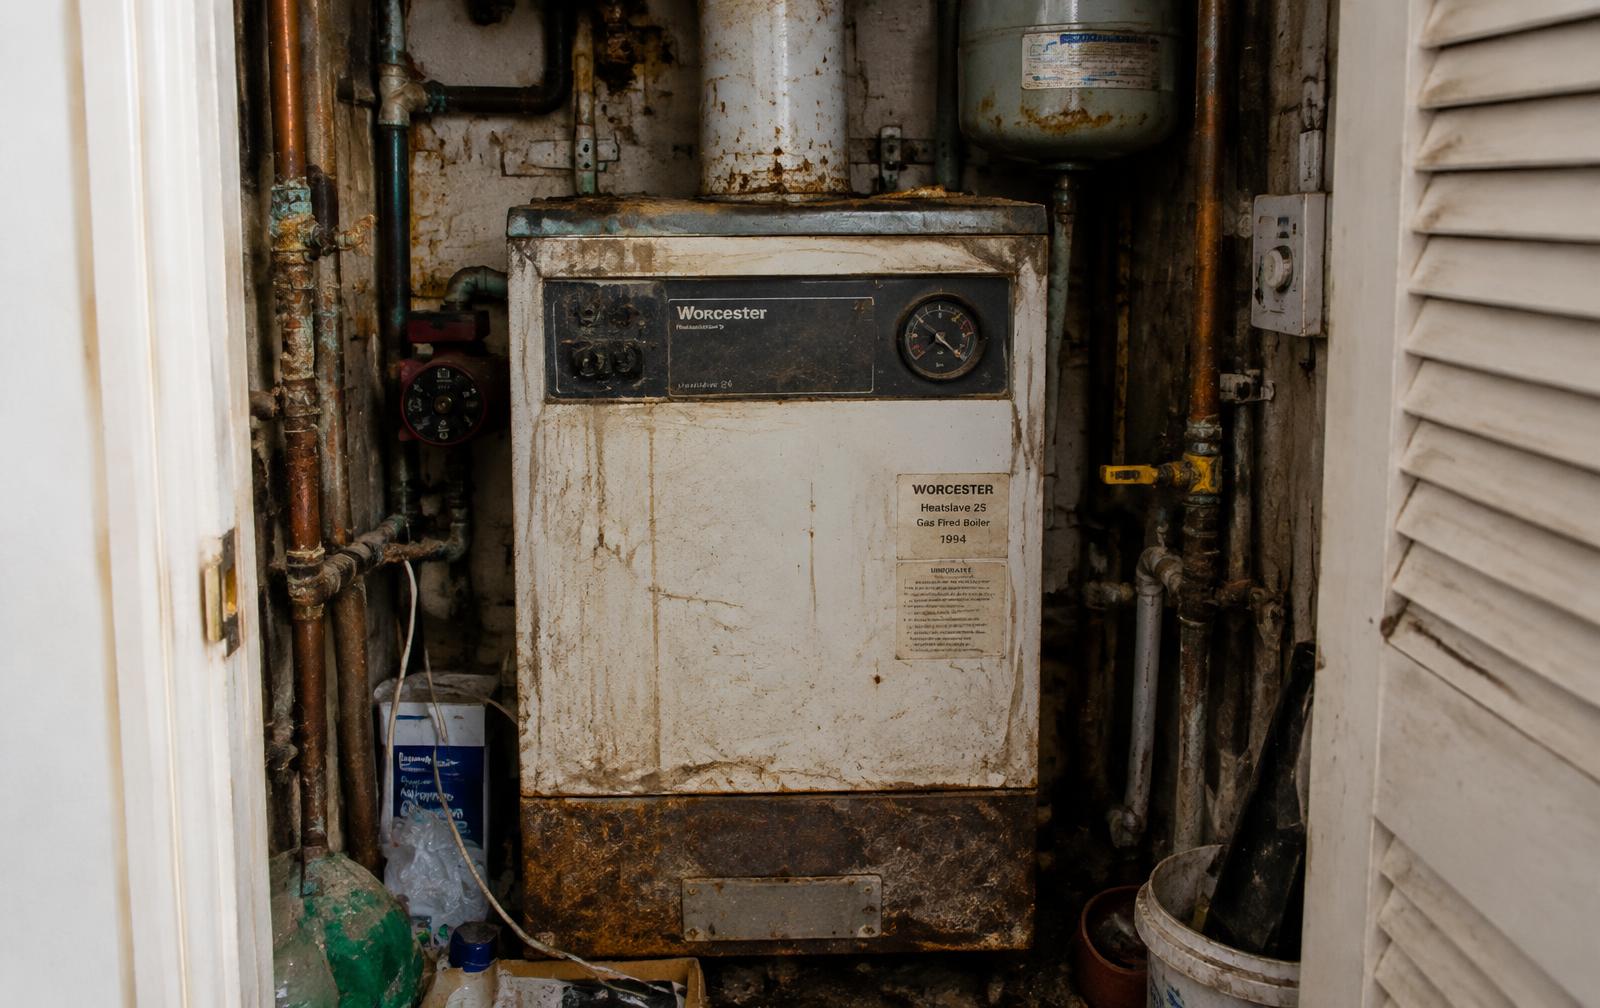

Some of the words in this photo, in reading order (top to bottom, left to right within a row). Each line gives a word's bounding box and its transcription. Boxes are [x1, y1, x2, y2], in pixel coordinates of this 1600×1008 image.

[912, 484, 994, 495] WORCESTER
[921, 503, 971, 512] Heatslave
[916, 518, 935, 527] Gas
[938, 518, 961, 527] Fired
[963, 518, 991, 527] Boiler
[940, 534, 967, 544] 1994
